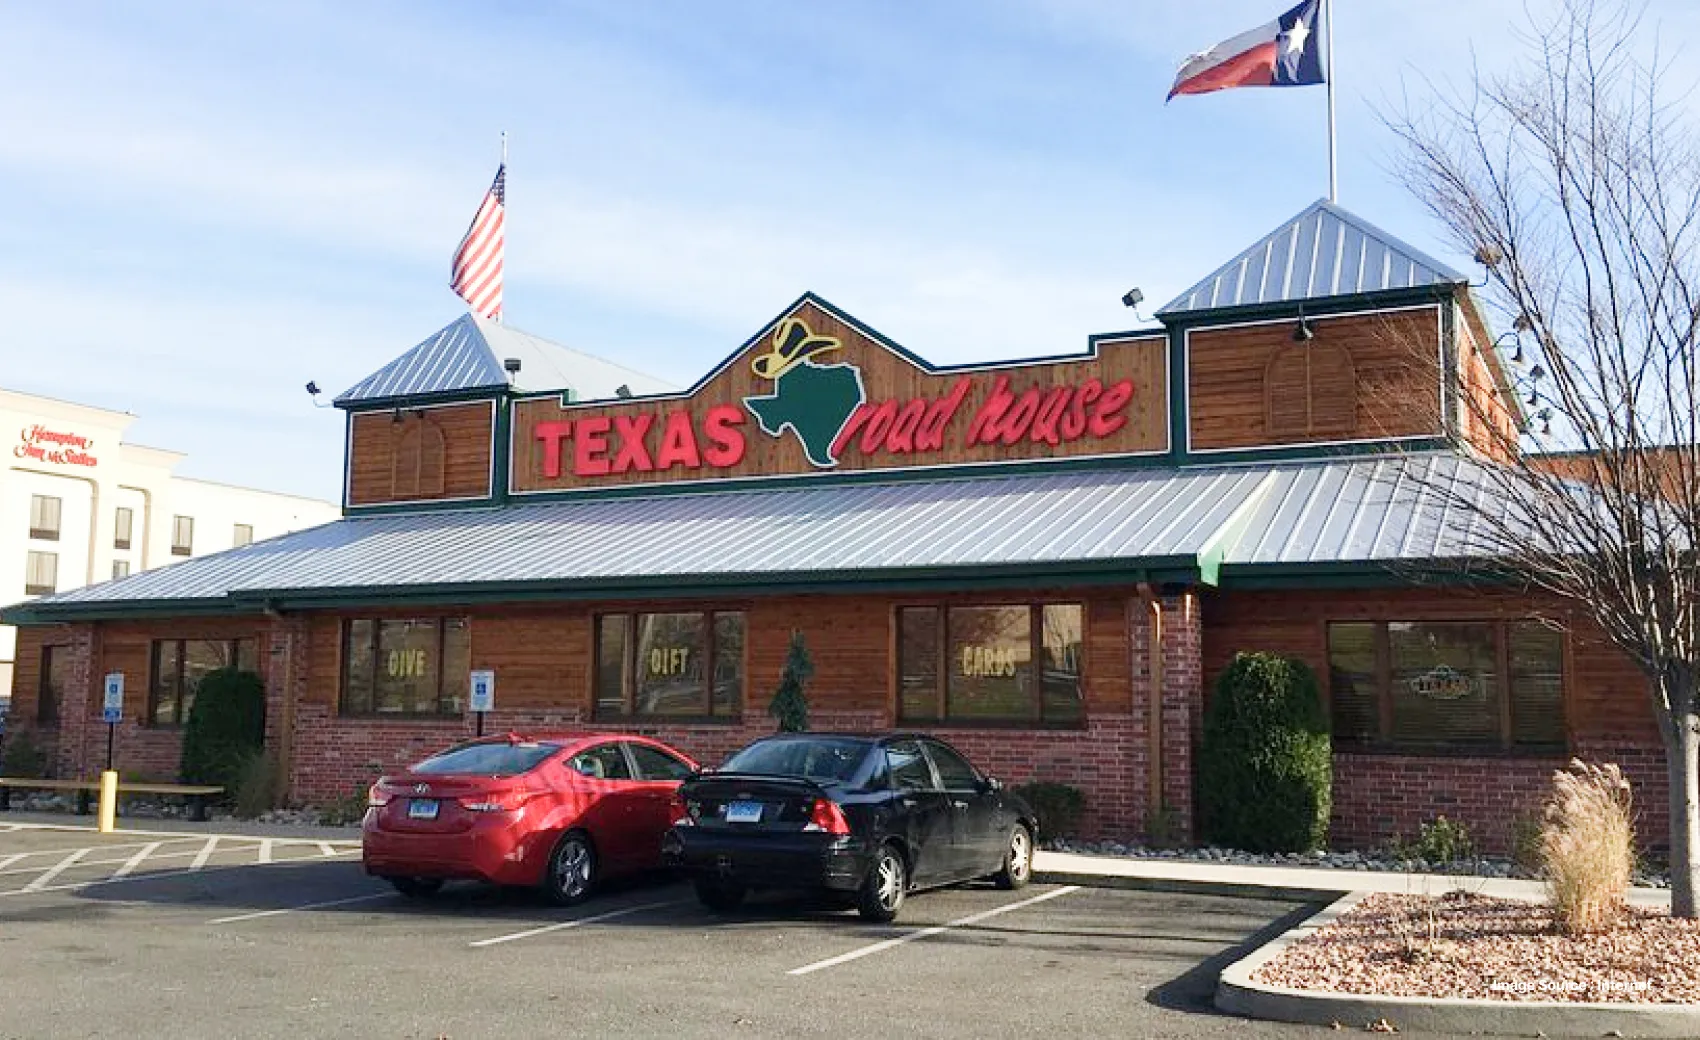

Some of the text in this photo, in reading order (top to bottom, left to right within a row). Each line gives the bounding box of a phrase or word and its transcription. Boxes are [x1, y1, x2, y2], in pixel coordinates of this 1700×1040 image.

[535, 374, 1134, 478] TEXAS road house
